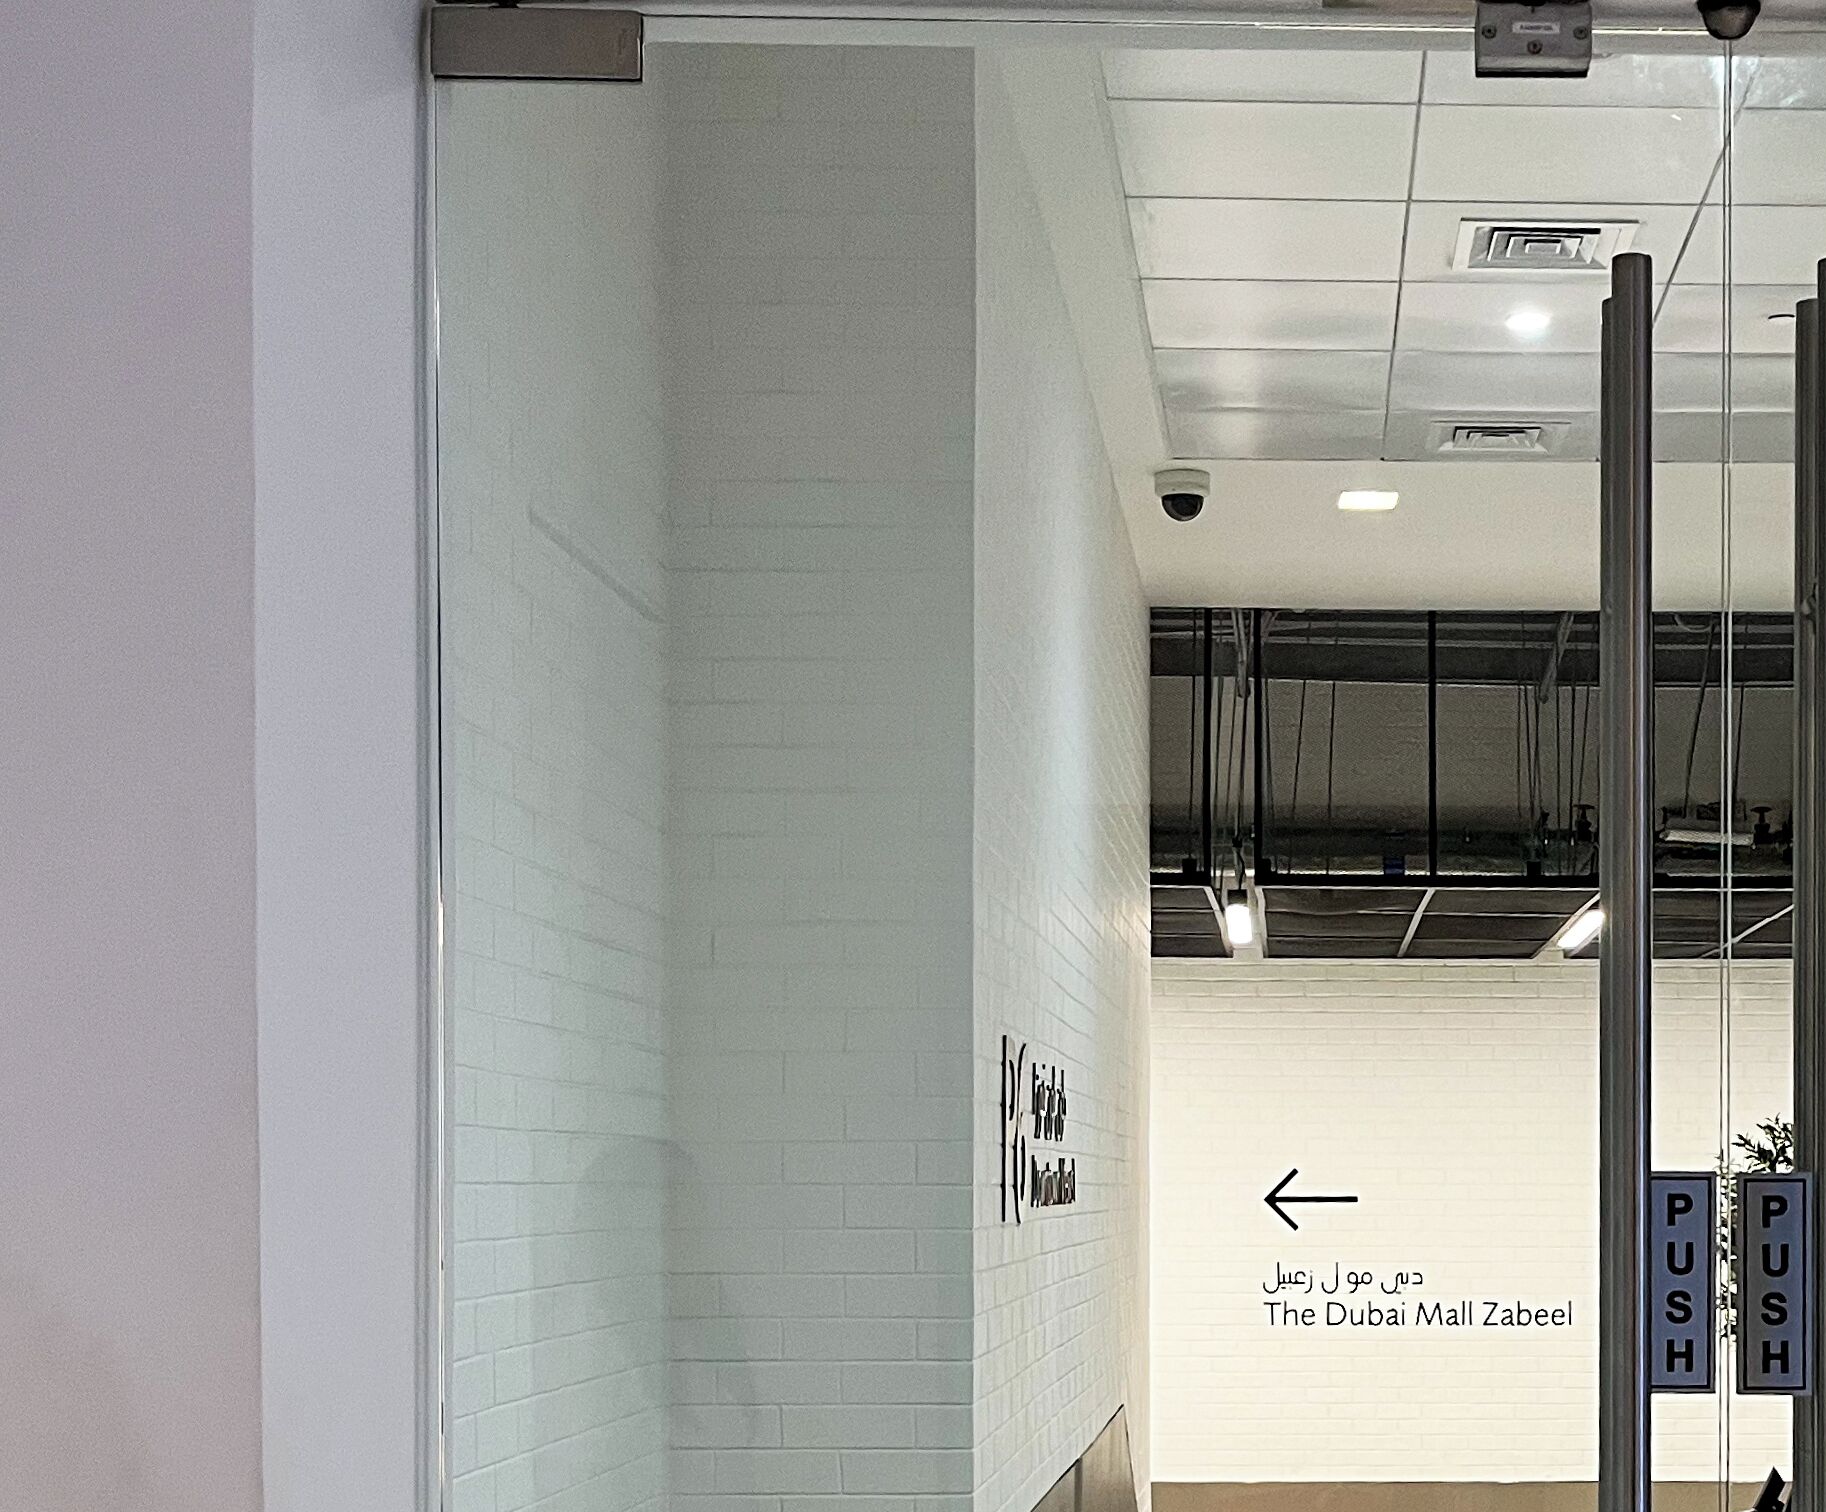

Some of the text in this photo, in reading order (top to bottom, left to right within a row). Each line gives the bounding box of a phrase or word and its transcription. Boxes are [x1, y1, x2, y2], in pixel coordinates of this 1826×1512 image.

[1262, 1261, 1313, 1295] زعبيل
[1380, 1271, 1424, 1295] دبي
[1665, 1192, 1694, 1373] PUSH
[1760, 1194, 1790, 1375] PUSH
[1263, 1300, 1573, 1327] The Dubai Mall Zabeel
